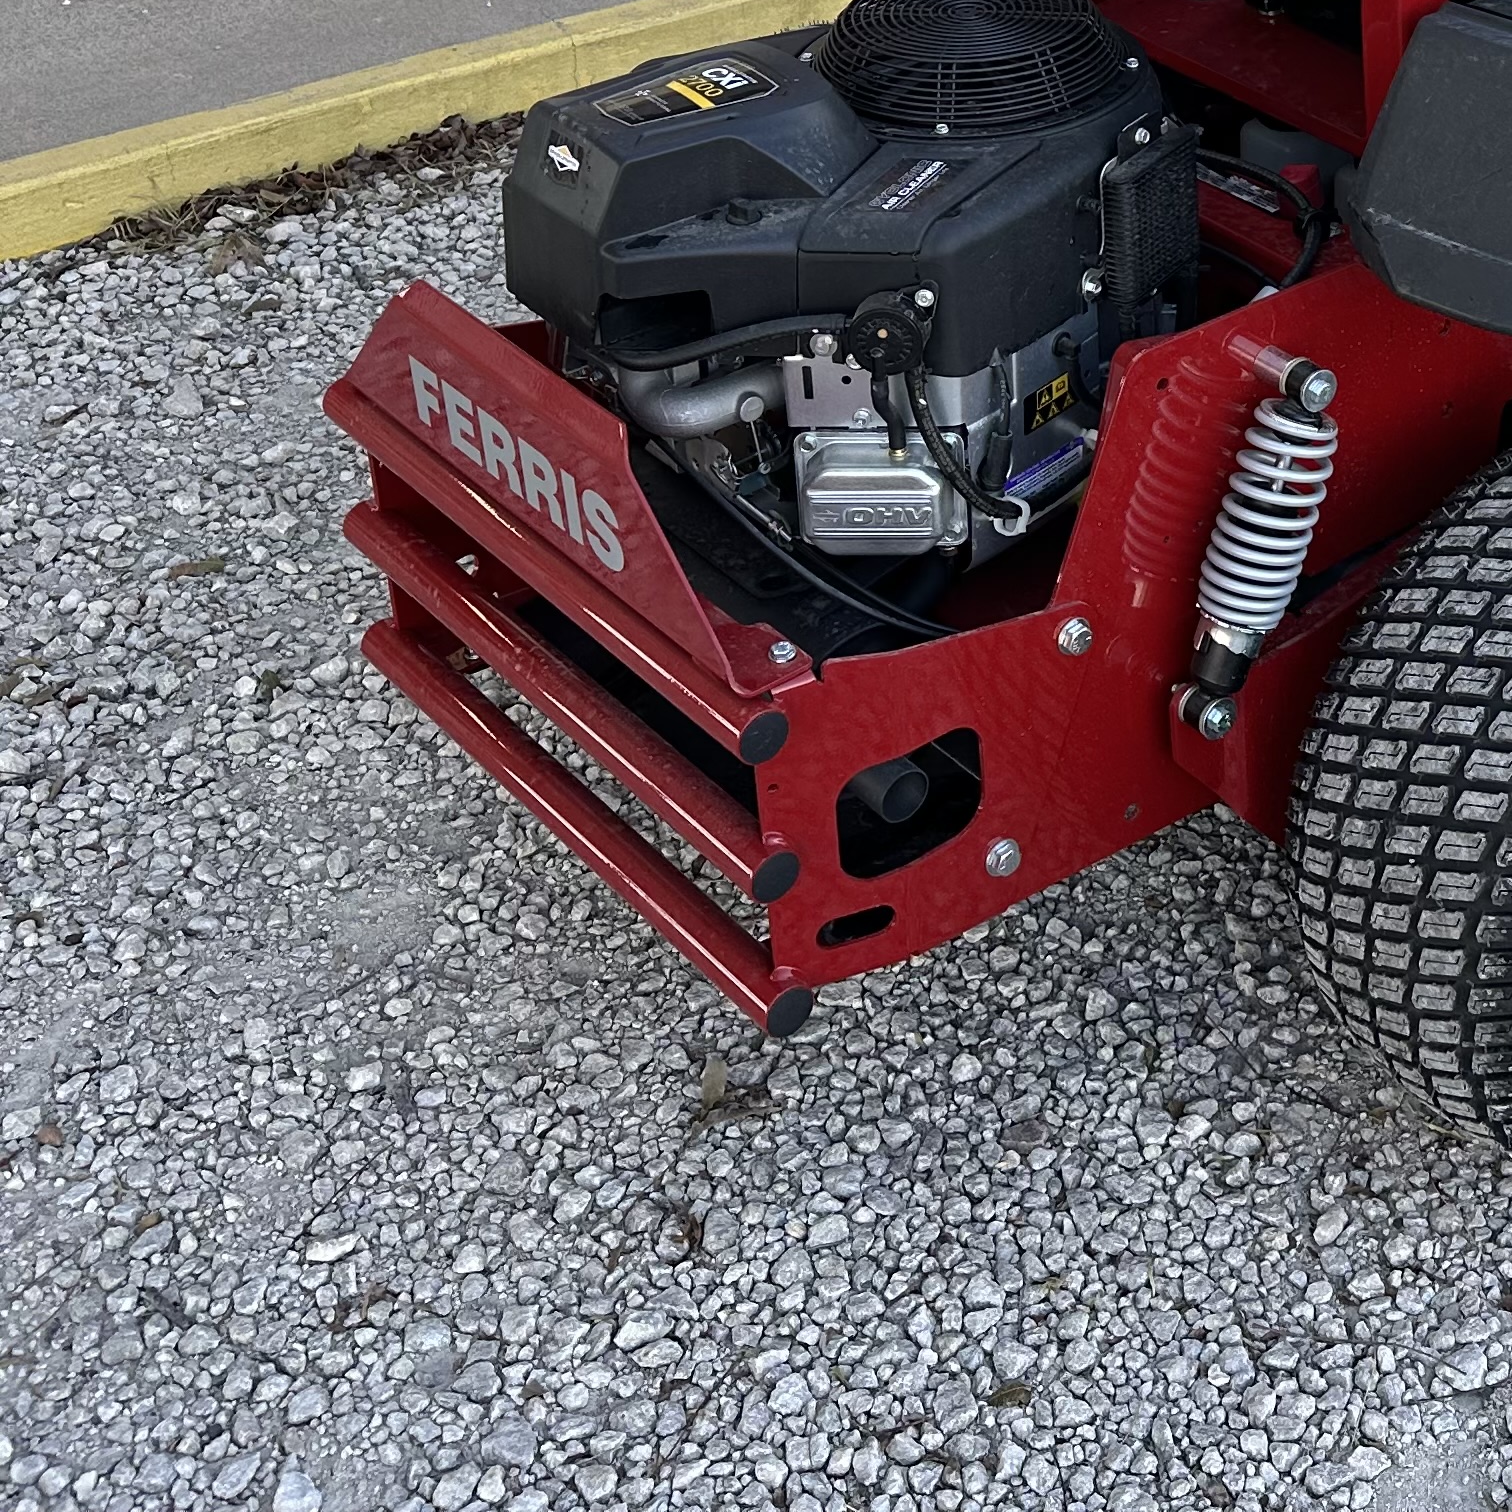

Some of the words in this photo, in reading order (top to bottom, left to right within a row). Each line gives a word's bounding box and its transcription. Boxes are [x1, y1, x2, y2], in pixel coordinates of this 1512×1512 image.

[678, 74, 724, 97] 2700
[881, 196, 901, 209] AIR
[408, 354, 624, 572] FERRIS
[843, 506, 932, 525] OHV
